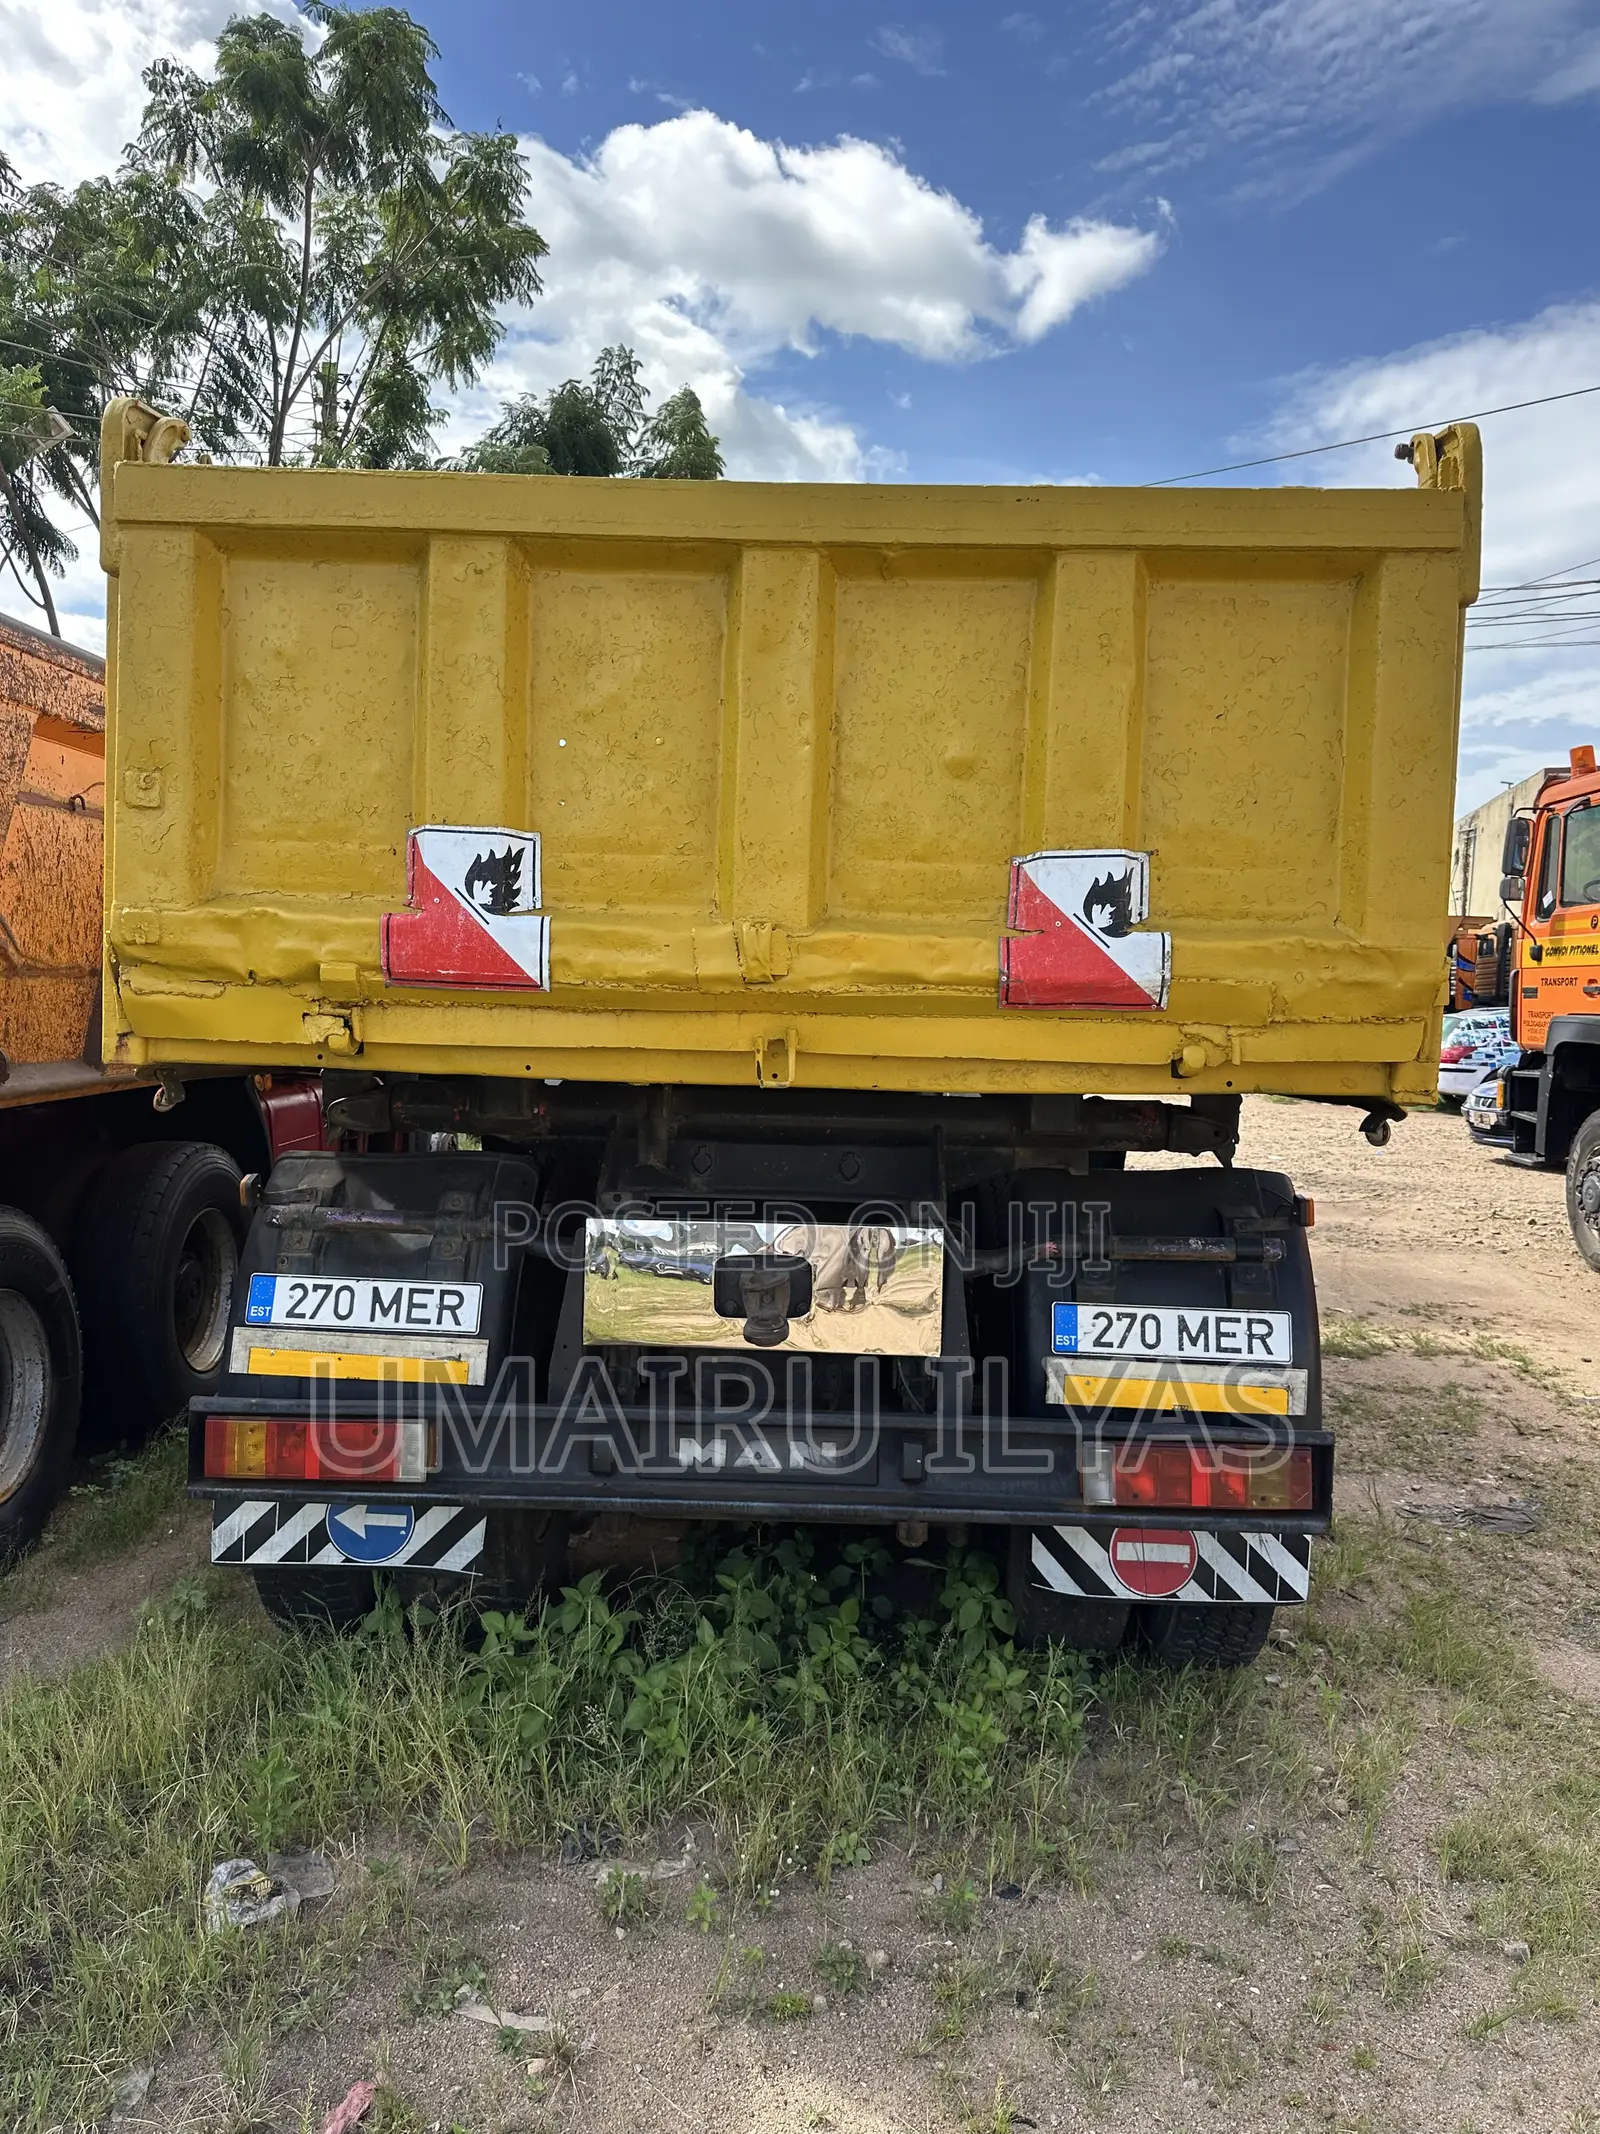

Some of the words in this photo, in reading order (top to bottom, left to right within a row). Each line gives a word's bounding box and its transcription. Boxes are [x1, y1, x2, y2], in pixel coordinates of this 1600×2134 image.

[1541, 977, 1578, 986] TRANSPORT
[250, 1306, 271, 1317] EST
[285, 1283, 355, 1321] 270
[370, 1286, 465, 1326] MER
[1055, 1335, 1076, 1346] EST
[1092, 1311, 1161, 1350] 270
[1177, 1314, 1274, 1355] MER
[679, 1437, 837, 1469] MAN
